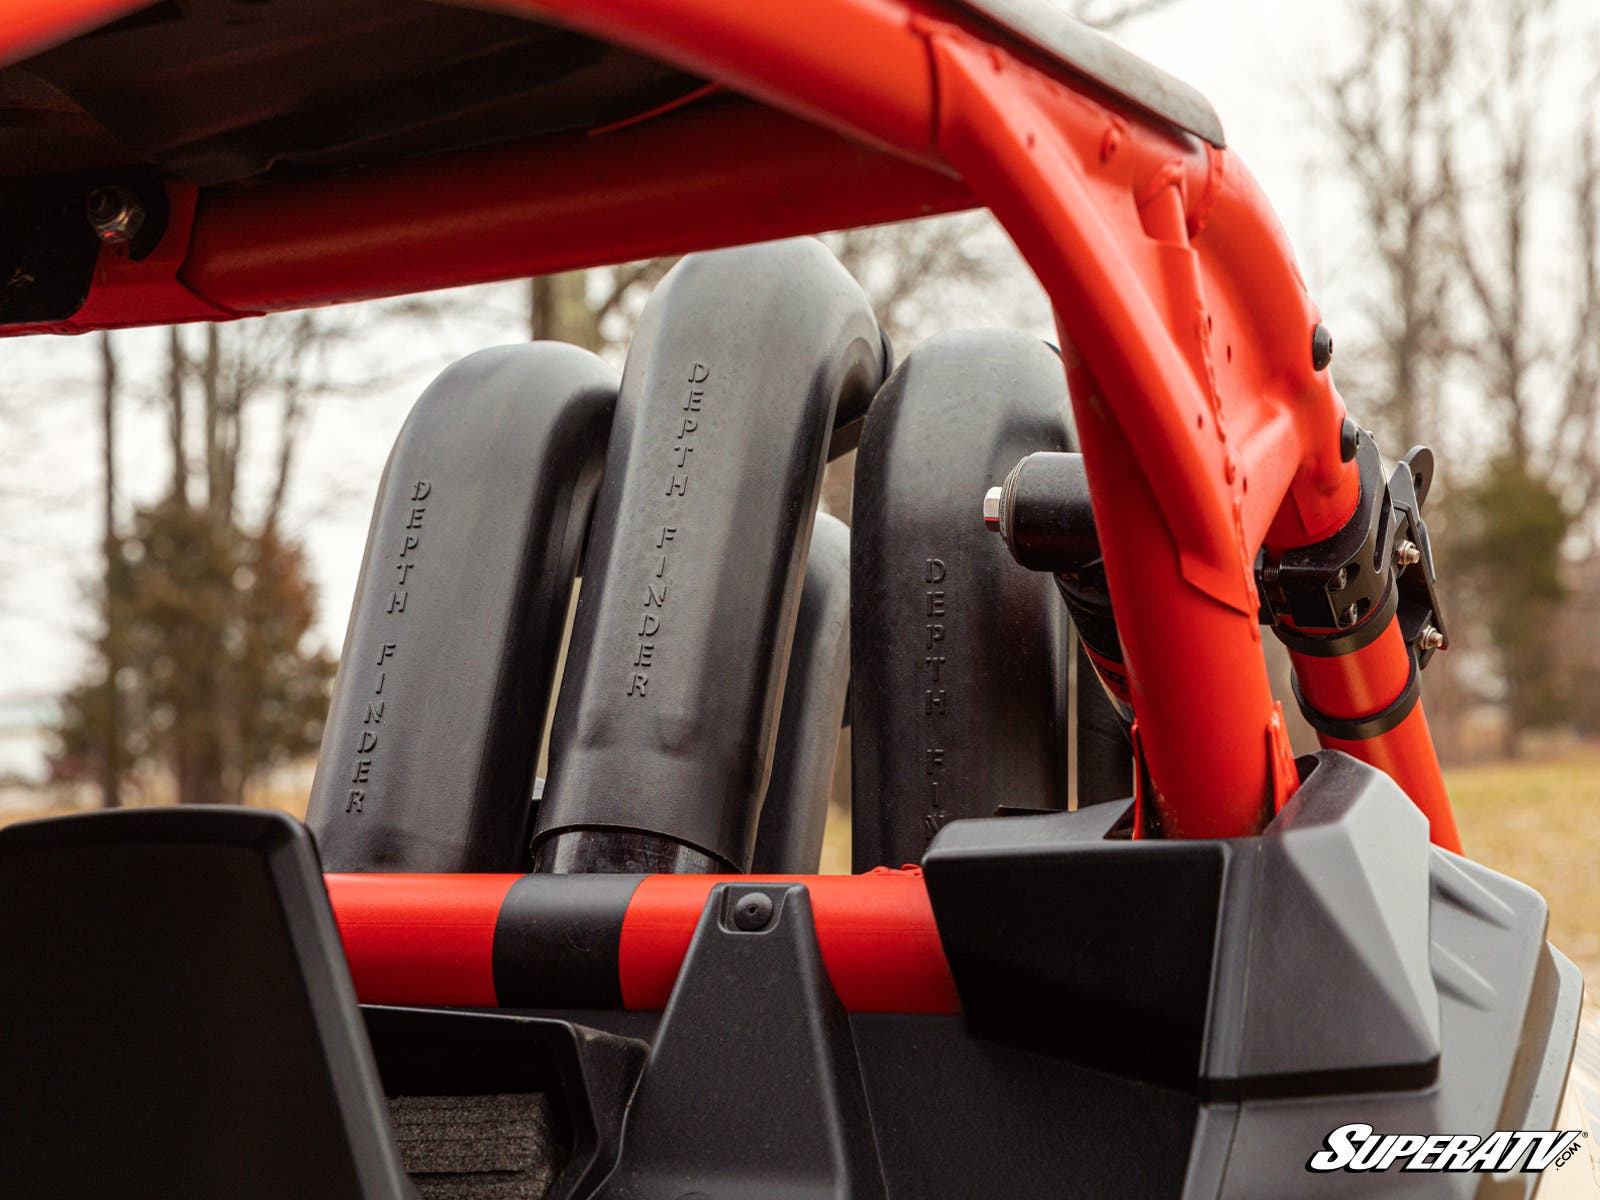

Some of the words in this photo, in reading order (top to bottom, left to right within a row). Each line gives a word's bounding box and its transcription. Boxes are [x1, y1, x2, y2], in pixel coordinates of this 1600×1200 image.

[664, 361, 710, 497] DEPTH
[386, 480, 432, 614] DEPTH
[626, 527, 677, 697] FINDER
[925, 558, 946, 716] DEPTH
[345, 642, 396, 813] FINDER
